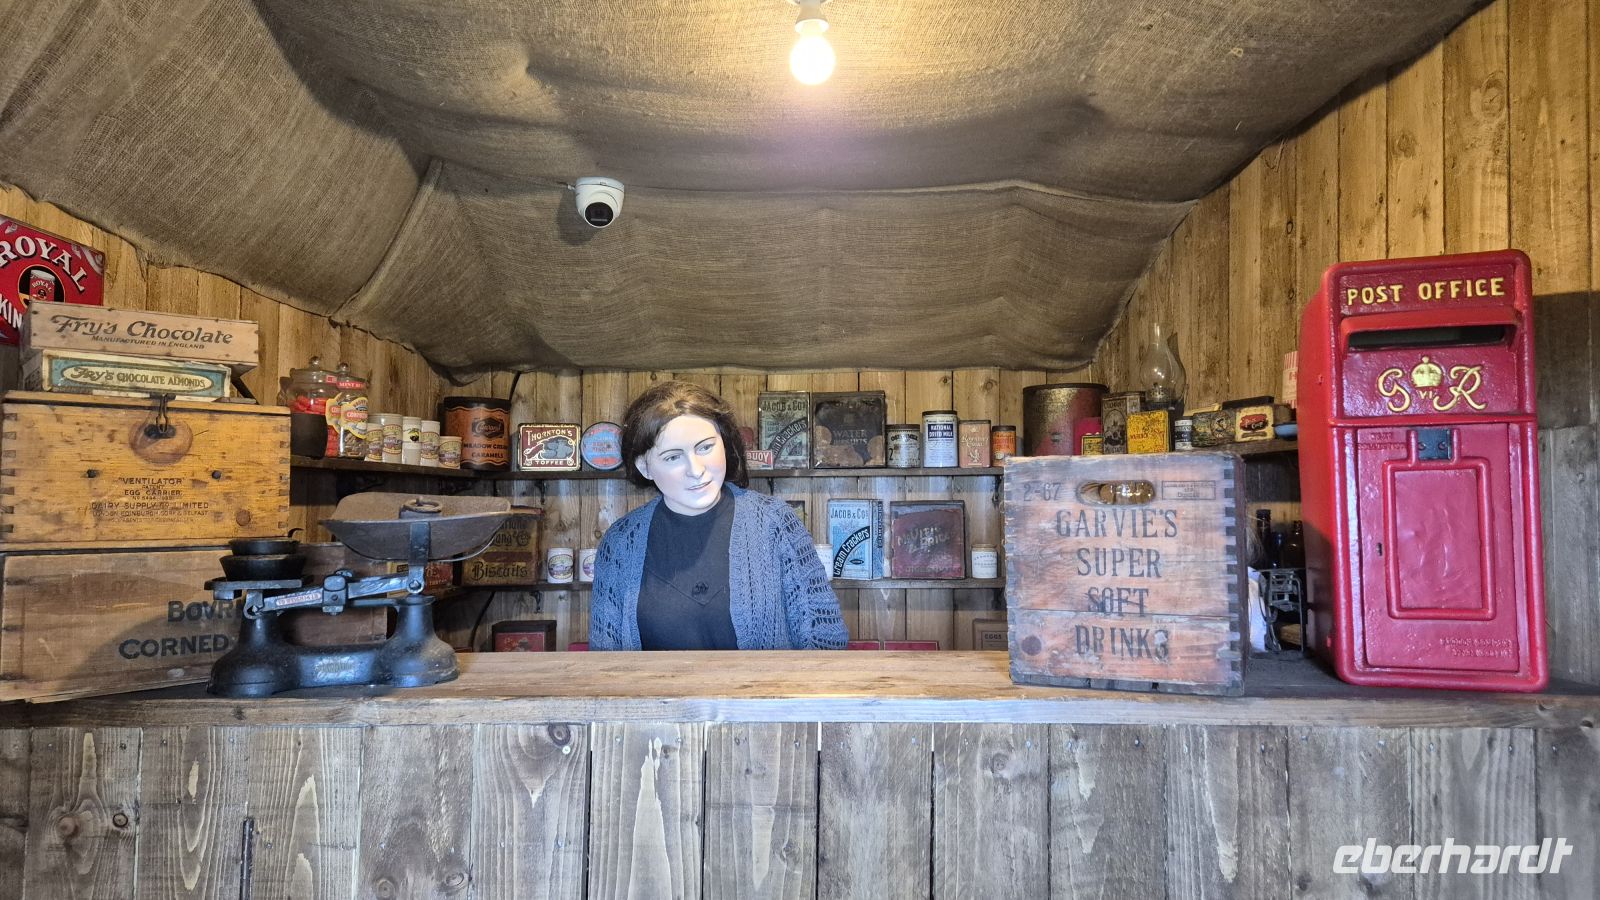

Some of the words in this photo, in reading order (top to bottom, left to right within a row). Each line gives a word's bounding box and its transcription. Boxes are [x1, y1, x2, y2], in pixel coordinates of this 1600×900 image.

[0, 236, 87, 292] ROYAL
[1347, 284, 1404, 306] POST
[1418, 277, 1505, 301] OFFICE
[51, 314, 118, 336] Fry's
[126, 320, 233, 345] Chocolate
[117, 372, 166, 384] CHOCOLATE
[168, 375, 205, 388] ALMONDS
[831, 507, 852, 519] JACOB
[1056, 508, 1178, 538] GARVIE'S
[834, 550, 848, 576] Cream
[842, 528, 870, 552] Crackers
[1077, 547, 1162, 578] SUPER
[471, 561, 528, 580] Biscuits
[1086, 586, 1149, 617] SOFT
[119, 634, 229, 660] CORNED
